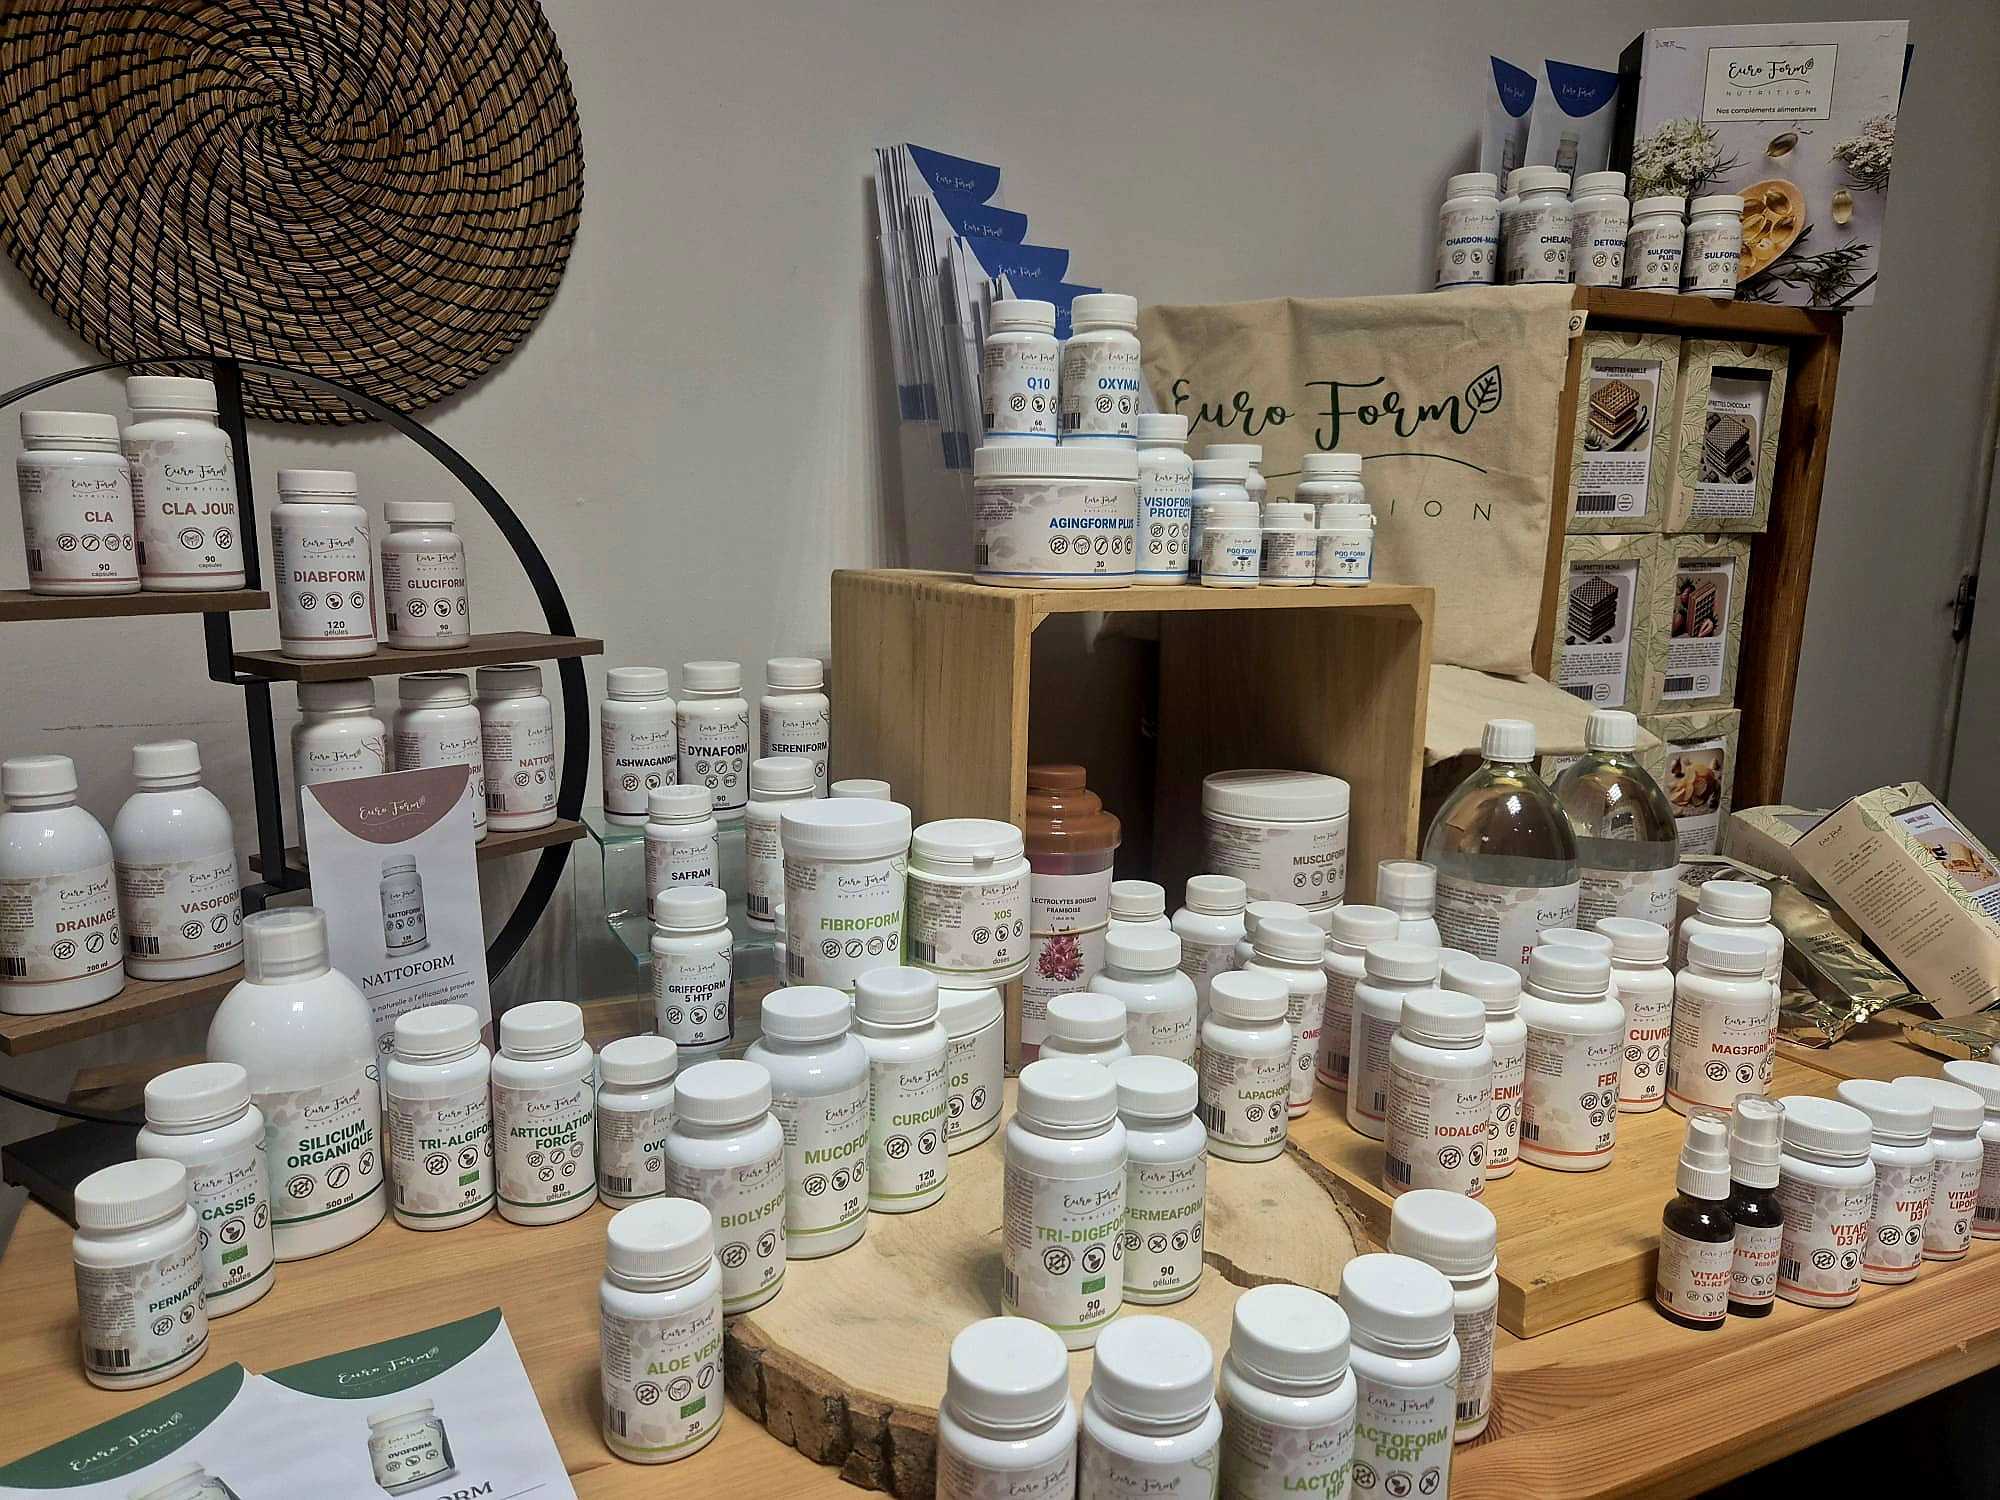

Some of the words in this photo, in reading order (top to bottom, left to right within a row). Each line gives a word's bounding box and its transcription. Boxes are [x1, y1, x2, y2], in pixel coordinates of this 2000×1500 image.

[1728, 61, 1763, 79] Euro
[1767, 59, 1807, 79] Form
[1726, 88, 1812, 97] NUTRITION
[1716, 104, 1730, 114] Nos
[1731, 104, 1775, 115] compléments
[1777, 103, 1817, 113] alimentaires
[1026, 377, 1050, 391] Q10
[1306, 375, 1483, 452] Form
[164, 463, 195, 478] Euro
[199, 464, 226, 480] Form
[161, 502, 197, 517] CLA
[200, 502, 235, 516] JOUR
[84, 511, 114, 523] CLA
[1049, 518, 1117, 530] AGINGFORM
[1118, 518, 1134, 530] PLUS
[98, 562, 110, 571] 90
[204, 555, 217, 564] 90
[293, 570, 366, 584] DIABFORM
[407, 577, 465, 590] GLUCIFORM
[327, 620, 346, 629] 120
[687, 742, 748, 763] DYNAFORM
[771, 740, 828, 757] SERENIFORM
[359, 803, 389, 821] Euro
[392, 799, 422, 818] Form
[671, 868, 712, 882] SAFRAN
[181, 888, 241, 915] VASOFORM
[993, 909, 1012, 921] XOS
[1046, 906, 1081, 915] FRAMBOISE
[55, 906, 117, 935] DRAINAGE
[820, 911, 900, 932] FIBROFORM
[996, 948, 1008, 957] 62
[361, 954, 457, 990] NATTOFORM
[668, 980, 727, 994] GRIFFOFORM
[685, 994, 693, 1004] 5
[694, 992, 713, 1004] HTP
[695, 1031, 705, 1040] 60
[1628, 1026, 1671, 1042] CUIVRE
[948, 1072, 969, 1089] OS
[1597, 1073, 1617, 1088] FER
[1645, 1085, 1655, 1094] 60
[892, 1101, 947, 1127] CURCUM
[510, 1110, 594, 1139] ARTICULATION
[1269, 1126, 1279, 1135] 90
[298, 1118, 366, 1153] SILICIUM
[535, 1132, 578, 1151] FORCE
[1597, 1132, 1610, 1144] 120
[286, 1128, 374, 1168] ORGANIQUE
[1492, 1148, 1508, 1158] 120
[918, 1169, 935, 1183] 120
[464, 1188, 477, 1199] 90
[552, 1183, 566, 1194] 80
[201, 1192, 256, 1222] CASSIS
[326, 1197, 345, 1210] 500
[720, 1188, 786, 1228] BIOLYSFO
[842, 1196, 859, 1212] 120
[1125, 1196, 1204, 1223] PERMEAFORM
[1909, 1210, 1923, 1222] D3
[1837, 1235, 1853, 1247] D3
[228, 1265, 244, 1279] 90
[763, 1267, 774, 1278] 90
[1159, 1265, 1175, 1277] 90
[1152, 1275, 1182, 1288] gélules
[1086, 1299, 1101, 1311] 90
[647, 1354, 691, 1376] ALOE
[693, 1334, 723, 1359] VERA
[337, 1365, 381, 1385] Euro
[387, 1352, 437, 1373] Form
[1374, 1446, 1424, 1462] FORT
[1283, 1456, 1354, 1492] LACTOFO
